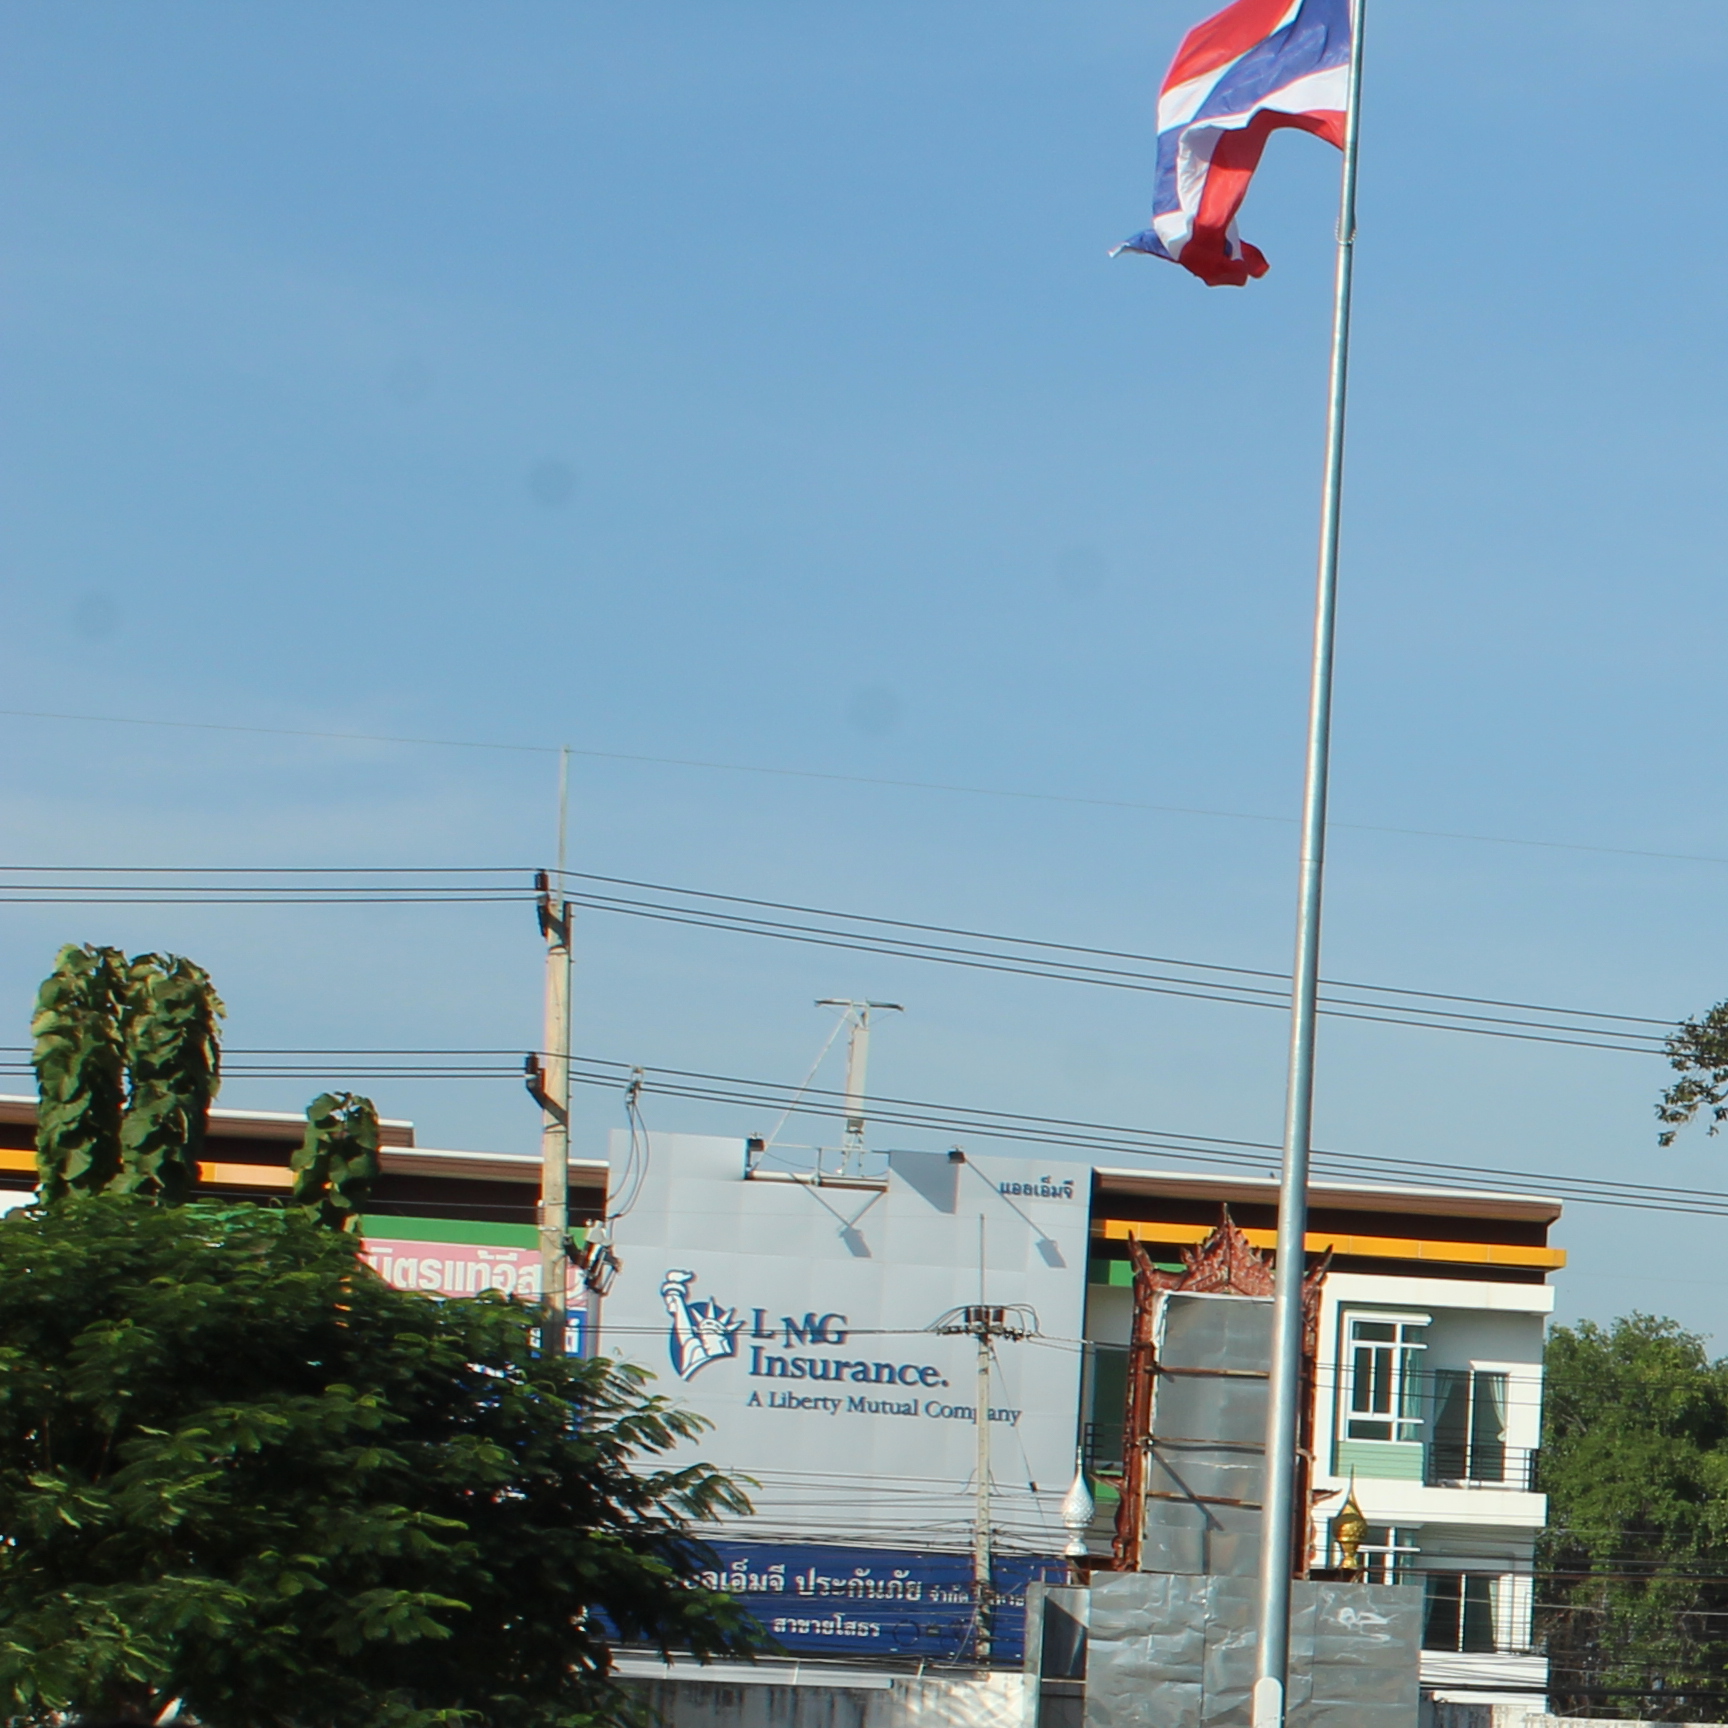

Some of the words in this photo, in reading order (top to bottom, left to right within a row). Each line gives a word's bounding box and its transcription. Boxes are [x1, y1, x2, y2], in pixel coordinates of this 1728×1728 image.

[750, 1307, 849, 1349] LMG
[748, 1345, 949, 1388] Insurance.
[747, 1390, 764, 1408] A
[768, 1391, 843, 1416] Liberty
[846, 1395, 919, 1417] Mutual
[795, 1567, 922, 1602] ประกันภัย
